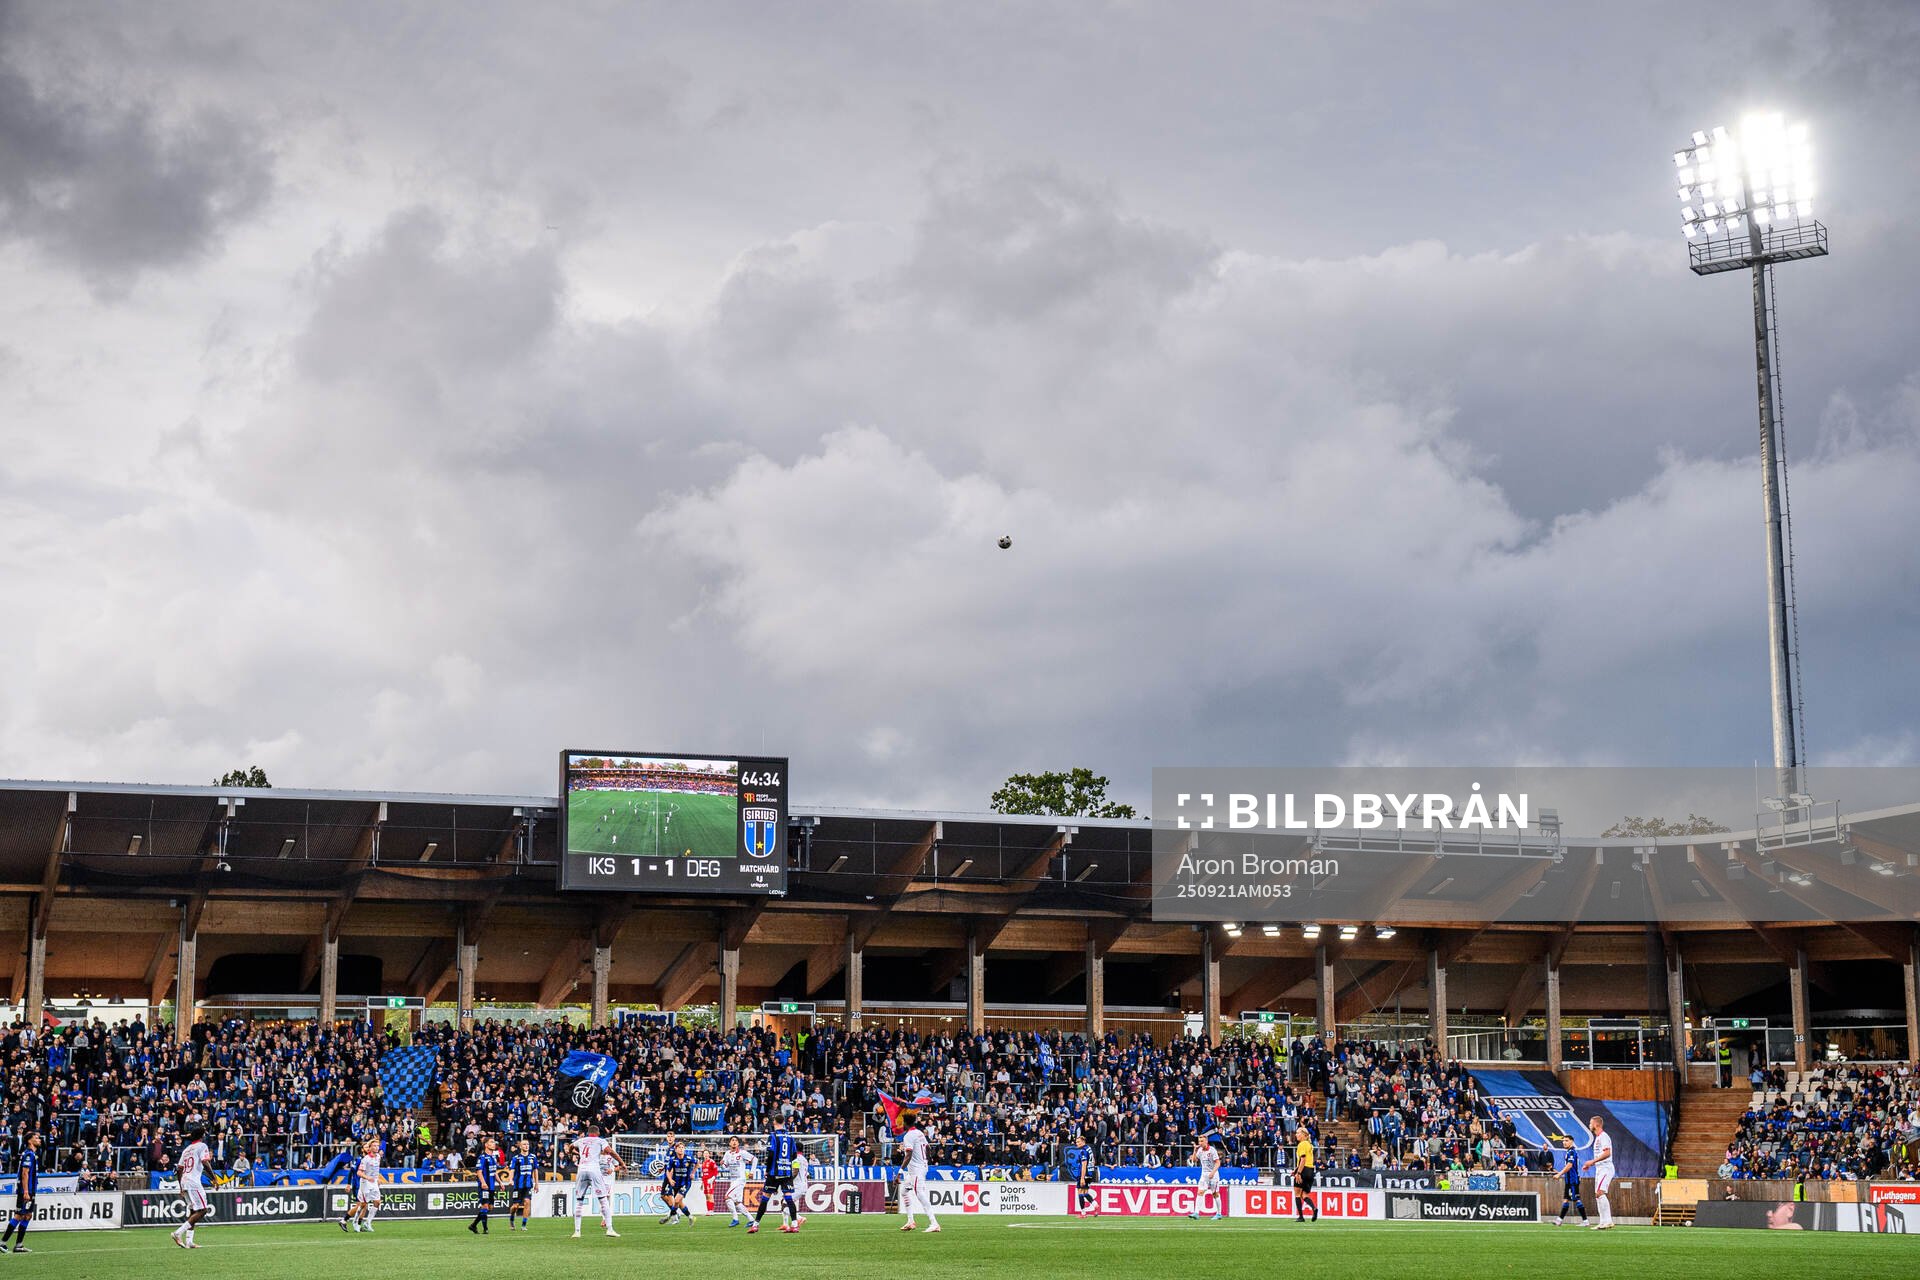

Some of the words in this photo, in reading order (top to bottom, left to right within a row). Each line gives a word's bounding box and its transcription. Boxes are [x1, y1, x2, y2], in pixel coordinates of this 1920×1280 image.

[741, 771, 780, 787] 64:34
[746, 810, 775, 820] SIRIUS
[588, 857, 616, 875] IKS
[631, 858, 640, 876] 1
[665, 859, 674, 877] 1
[686, 859, 721, 877] DEG
[462, 1010, 473, 1018] 21
[851, 1011, 861, 1019] 20
[1795, 1034, 1805, 1042] 18
[1494, 1098, 1564, 1109] SIRIUS
[582, 1145, 590, 1158] 4
[781, 1142, 788, 1157] 9
[1000, 1185, 1026, 1194] Doors
[929, 1190, 991, 1206] DALOC
[1000, 1194, 1020, 1203] with
[1074, 1187, 1219, 1214] BEVEGO
[1880, 1191, 1916, 1201] Luthagens
[89, 1202, 114, 1219] AB
[236, 1196, 308, 1216] inkClub
[1000, 1203, 1038, 1213] purpose.
[1423, 1202, 1477, 1219] Railway
[1479, 1203, 1529, 1219] System
